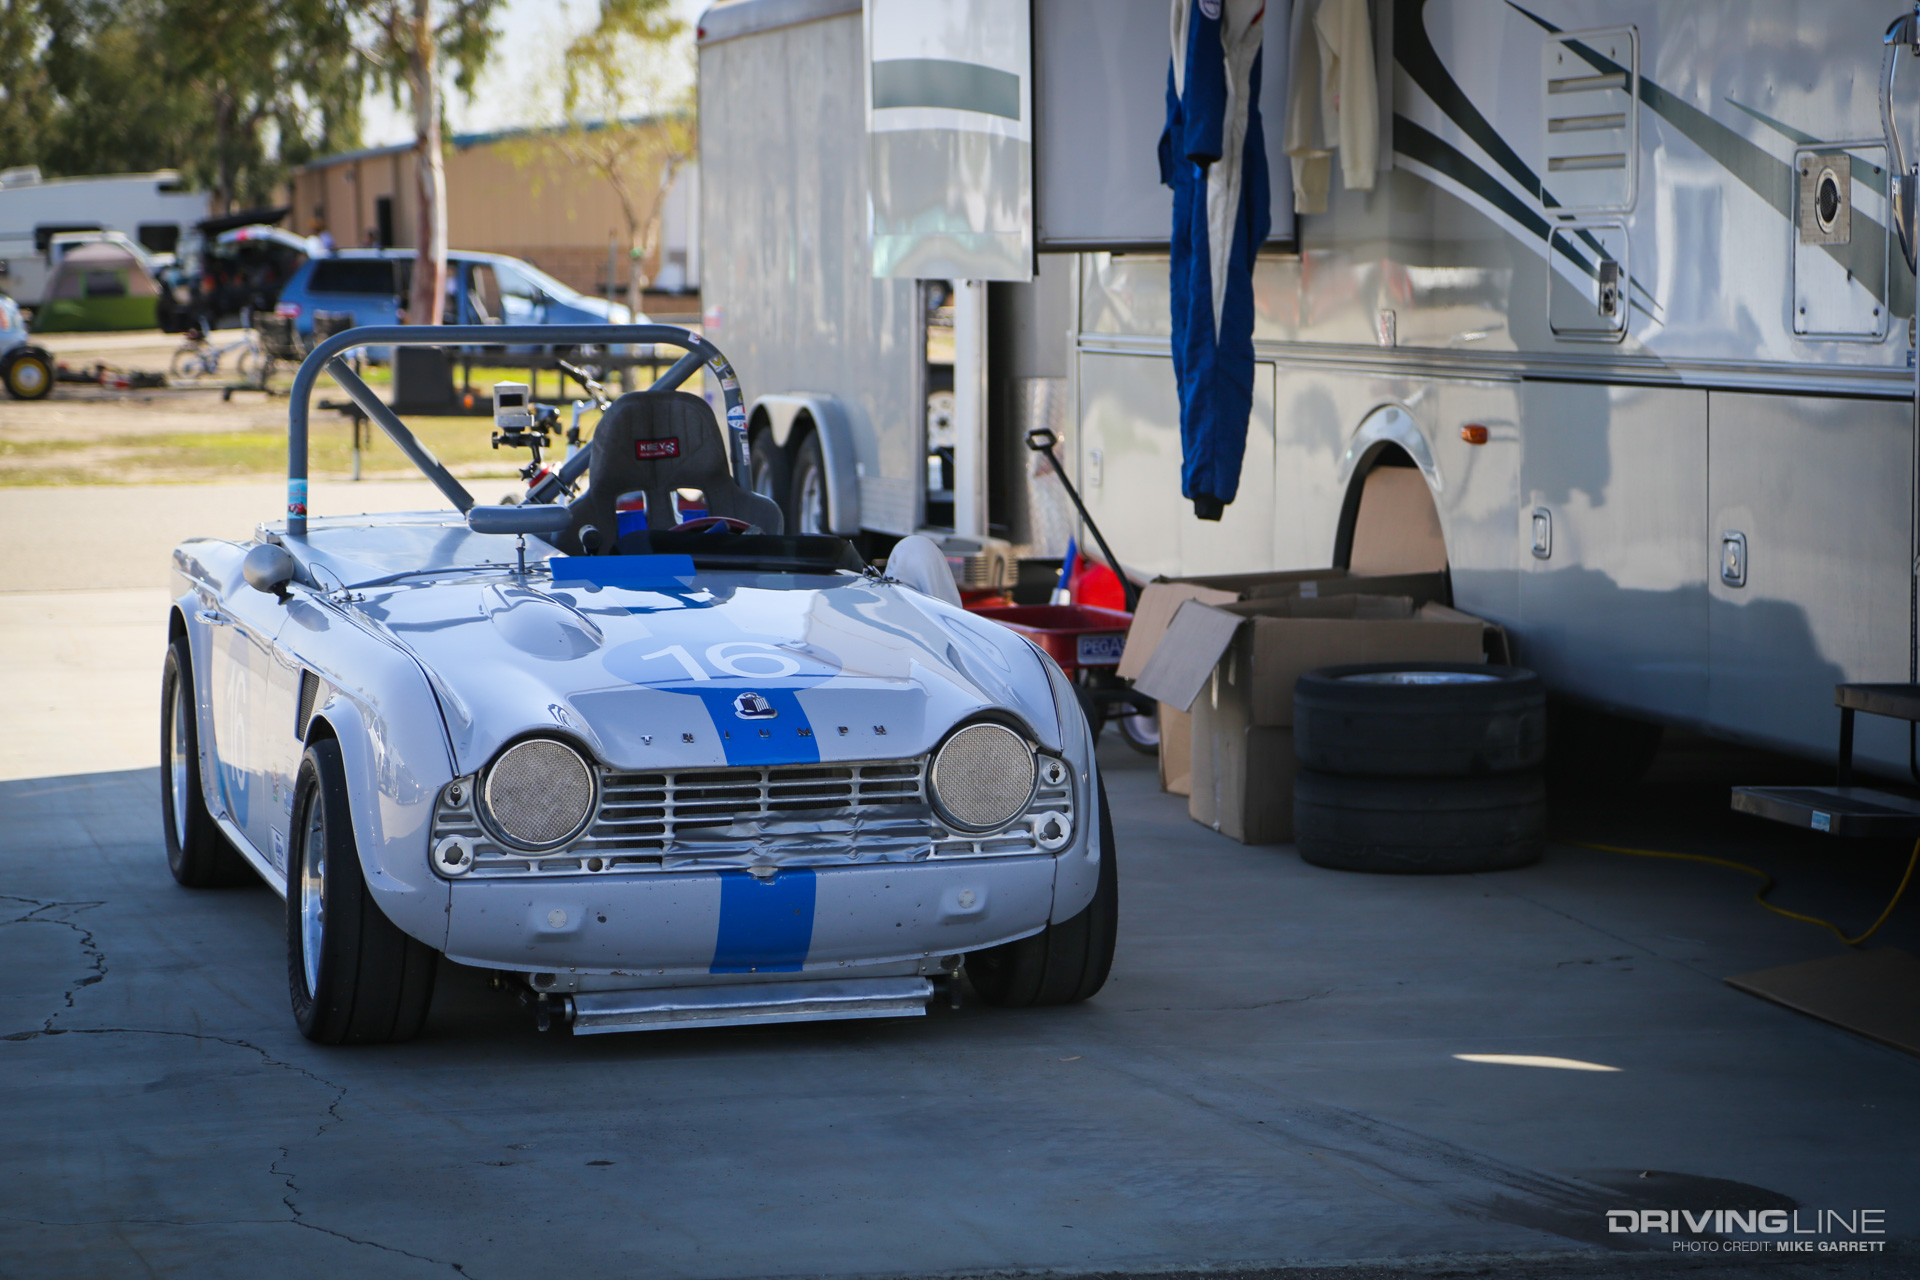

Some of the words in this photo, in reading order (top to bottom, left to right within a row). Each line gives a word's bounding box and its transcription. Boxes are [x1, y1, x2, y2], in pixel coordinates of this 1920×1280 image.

[641, 641, 801, 682] 16
[227, 663, 248, 791] 16
[641, 724, 887, 745] TRIUMPH
